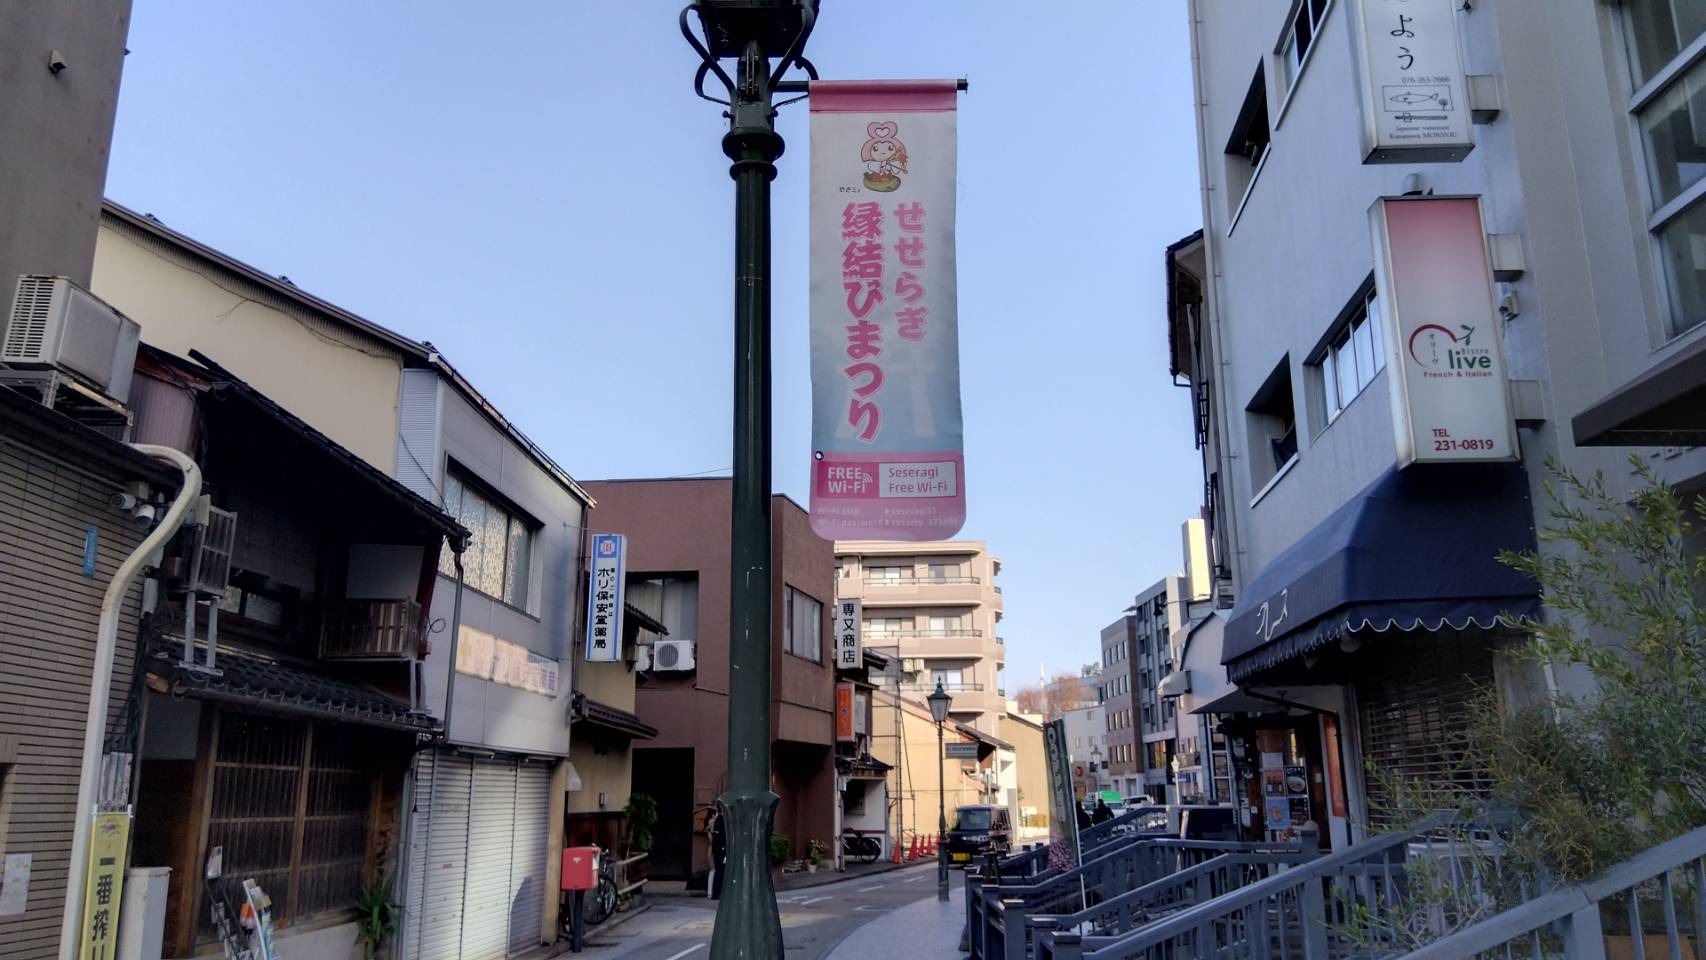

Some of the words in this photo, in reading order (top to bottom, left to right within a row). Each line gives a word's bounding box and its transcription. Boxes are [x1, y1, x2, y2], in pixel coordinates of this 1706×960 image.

[1389, 0, 1415, 70] よう
[894, 201, 927, 341] せせらぎ
[842, 201, 885, 443] 縁結びまつり
[1432, 428, 1450, 438] TEL
[1434, 439, 1494, 451] 231-0819
[828, 467, 862, 479] FREE
[889, 466, 938, 479] Seseragi
[828, 480, 865, 493] Wi-Fi
[889, 483, 914, 493] Free
[918, 481, 947, 492] Wi-Fi
[594, 568, 610, 649] ホリ保安堂薬局
[842, 603, 855, 664] 専又商店
